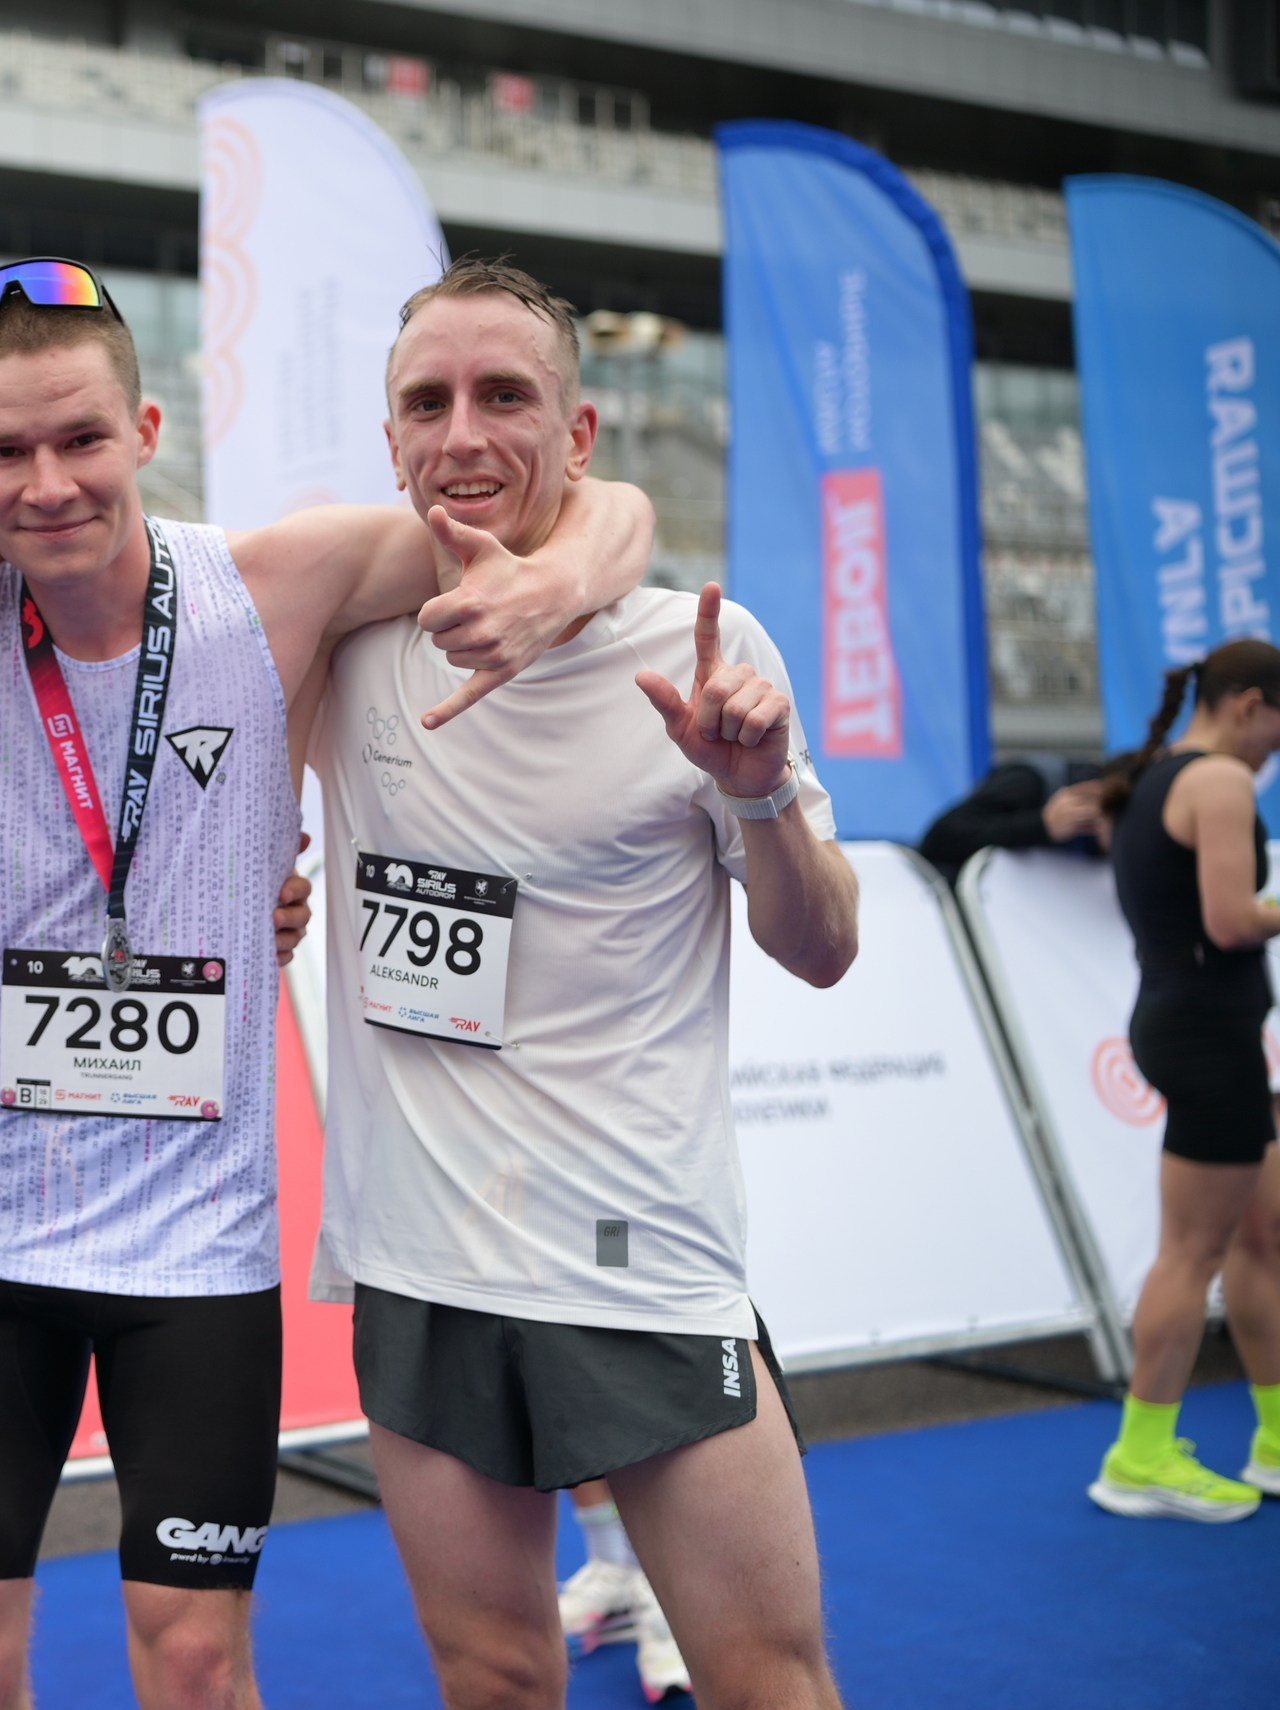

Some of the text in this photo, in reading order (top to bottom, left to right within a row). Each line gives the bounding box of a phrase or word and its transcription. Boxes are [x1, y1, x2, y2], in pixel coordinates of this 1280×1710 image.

[135, 625, 170, 756] SIRIUS
[60, 741, 94, 809] МАГНИТ
[122, 767, 149, 843] RAY
[417, 878, 457, 893] SIRIUS
[415, 887, 456, 900] AUTODROM
[360, 899, 484, 976] 7798
[27, 960, 44, 974] 10
[370, 964, 439, 990] ALEKSANDR
[25, 995, 199, 1055] 7280
[448, 1017, 481, 1032] RAY
[73, 1056, 142, 1071] МИХАИЛ
[20, 1087, 32, 1103] B
[68, 1092, 102, 1100] МАГНИТ
[167, 1095, 200, 1107] RAY
